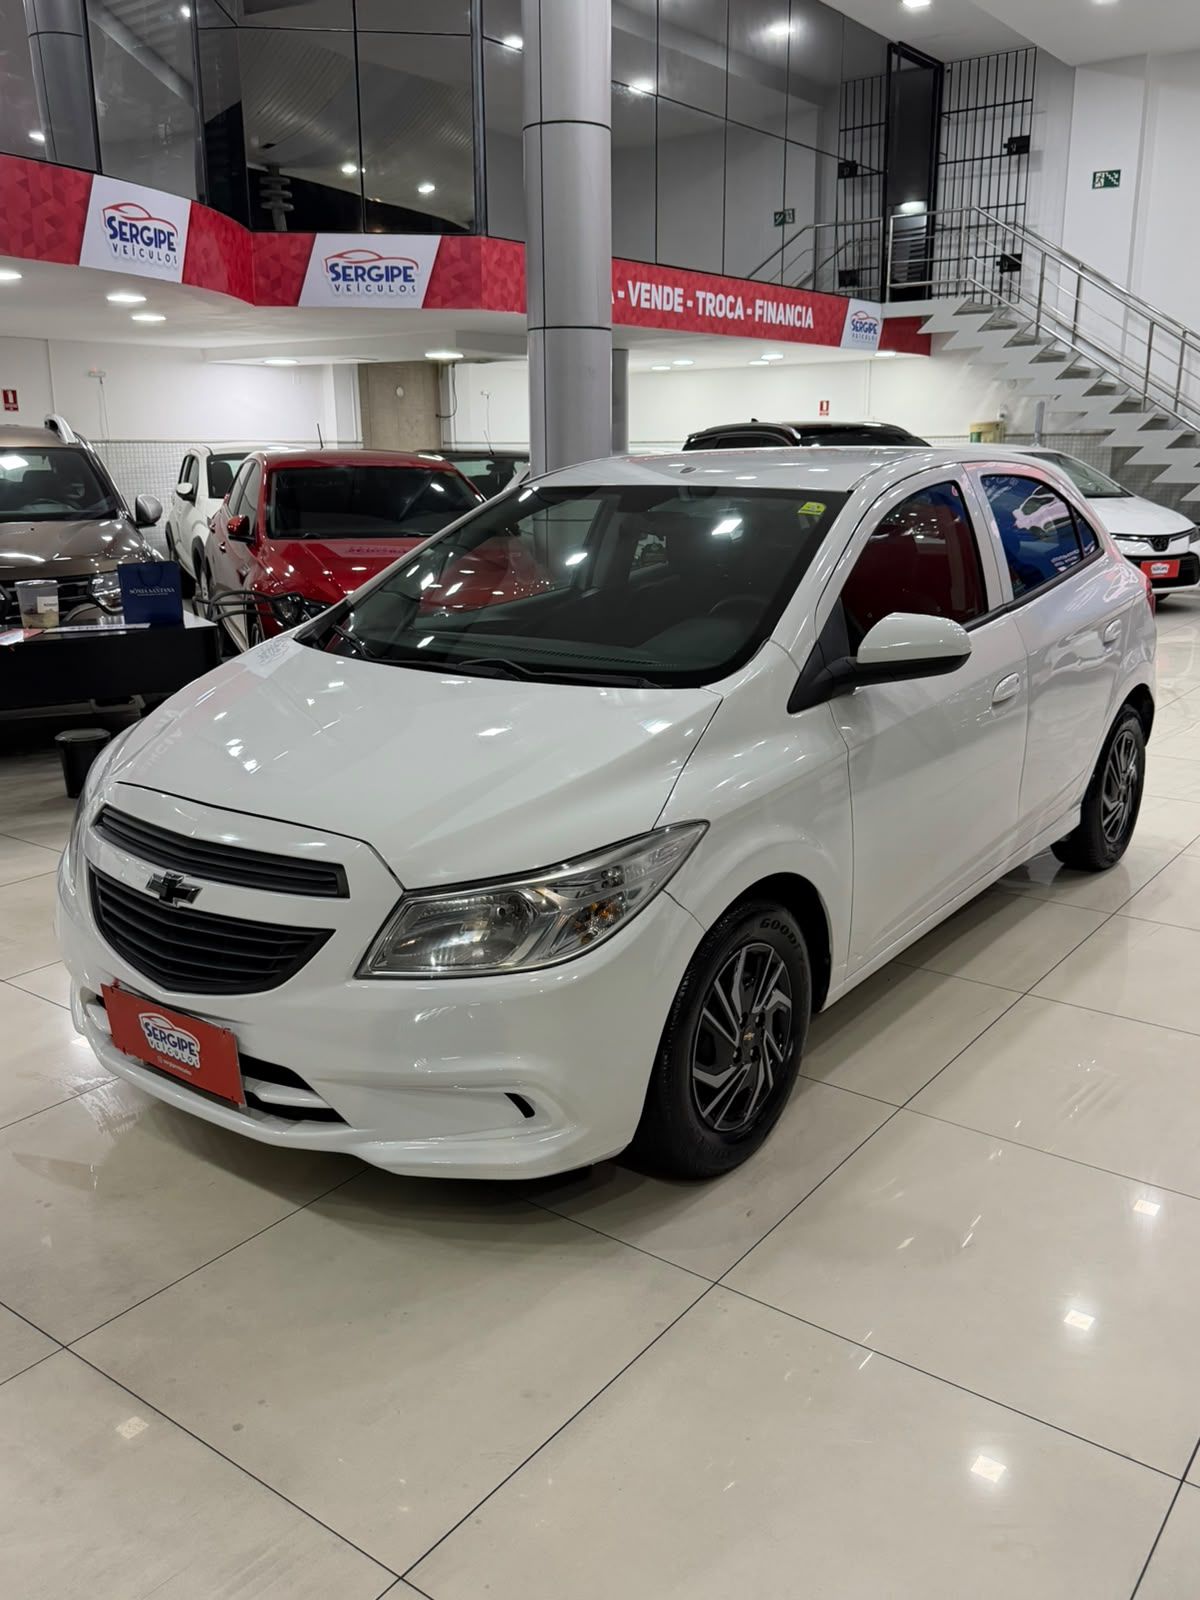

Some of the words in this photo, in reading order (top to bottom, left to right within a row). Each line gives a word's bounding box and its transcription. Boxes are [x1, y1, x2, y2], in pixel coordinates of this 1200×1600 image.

[107, 216, 176, 252] SERGIPE
[329, 263, 415, 282] SERGIPE
[627, 280, 684, 312] VENDE
[696, 290, 744, 320] TROCA
[755, 299, 814, 328] FINANCIA
[145, 1022, 197, 1057] SERGIPE
